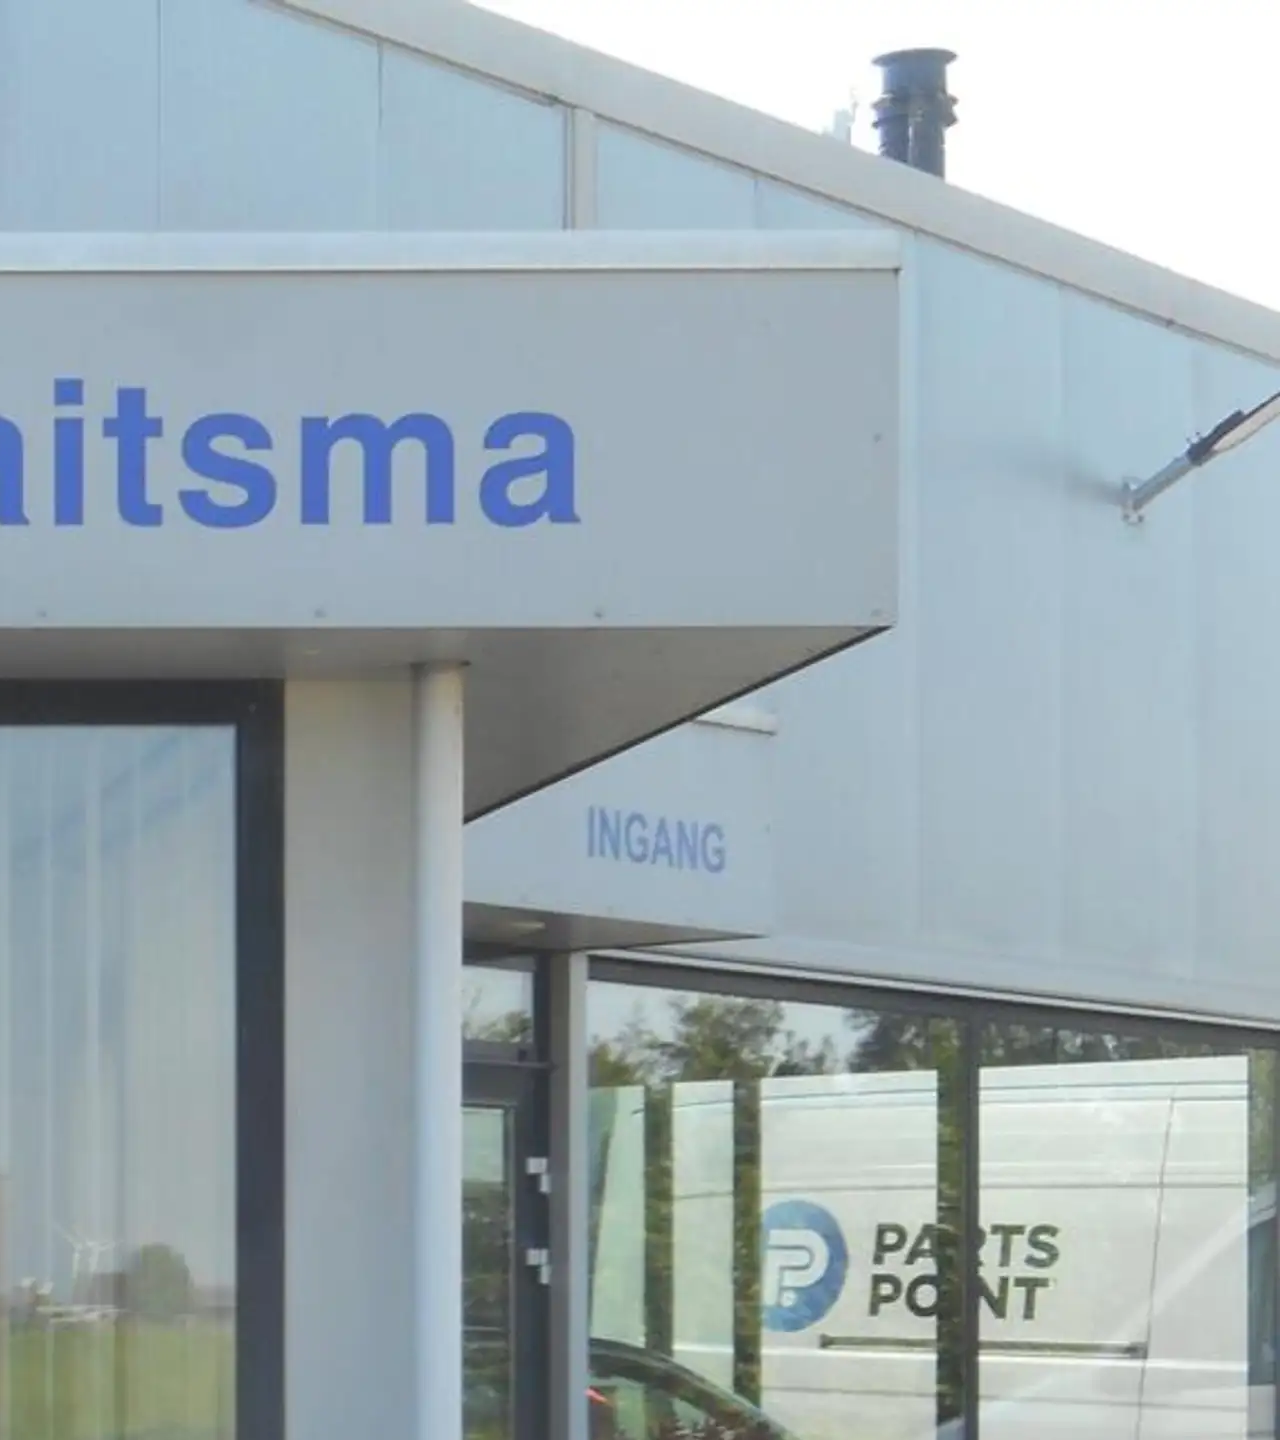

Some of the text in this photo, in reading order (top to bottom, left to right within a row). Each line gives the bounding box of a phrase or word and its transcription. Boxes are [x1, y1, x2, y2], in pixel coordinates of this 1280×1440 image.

[587, 806, 726, 873] INGANG
[871, 1223, 1061, 1268] PATS
[867, 1274, 1049, 1320] PONT
